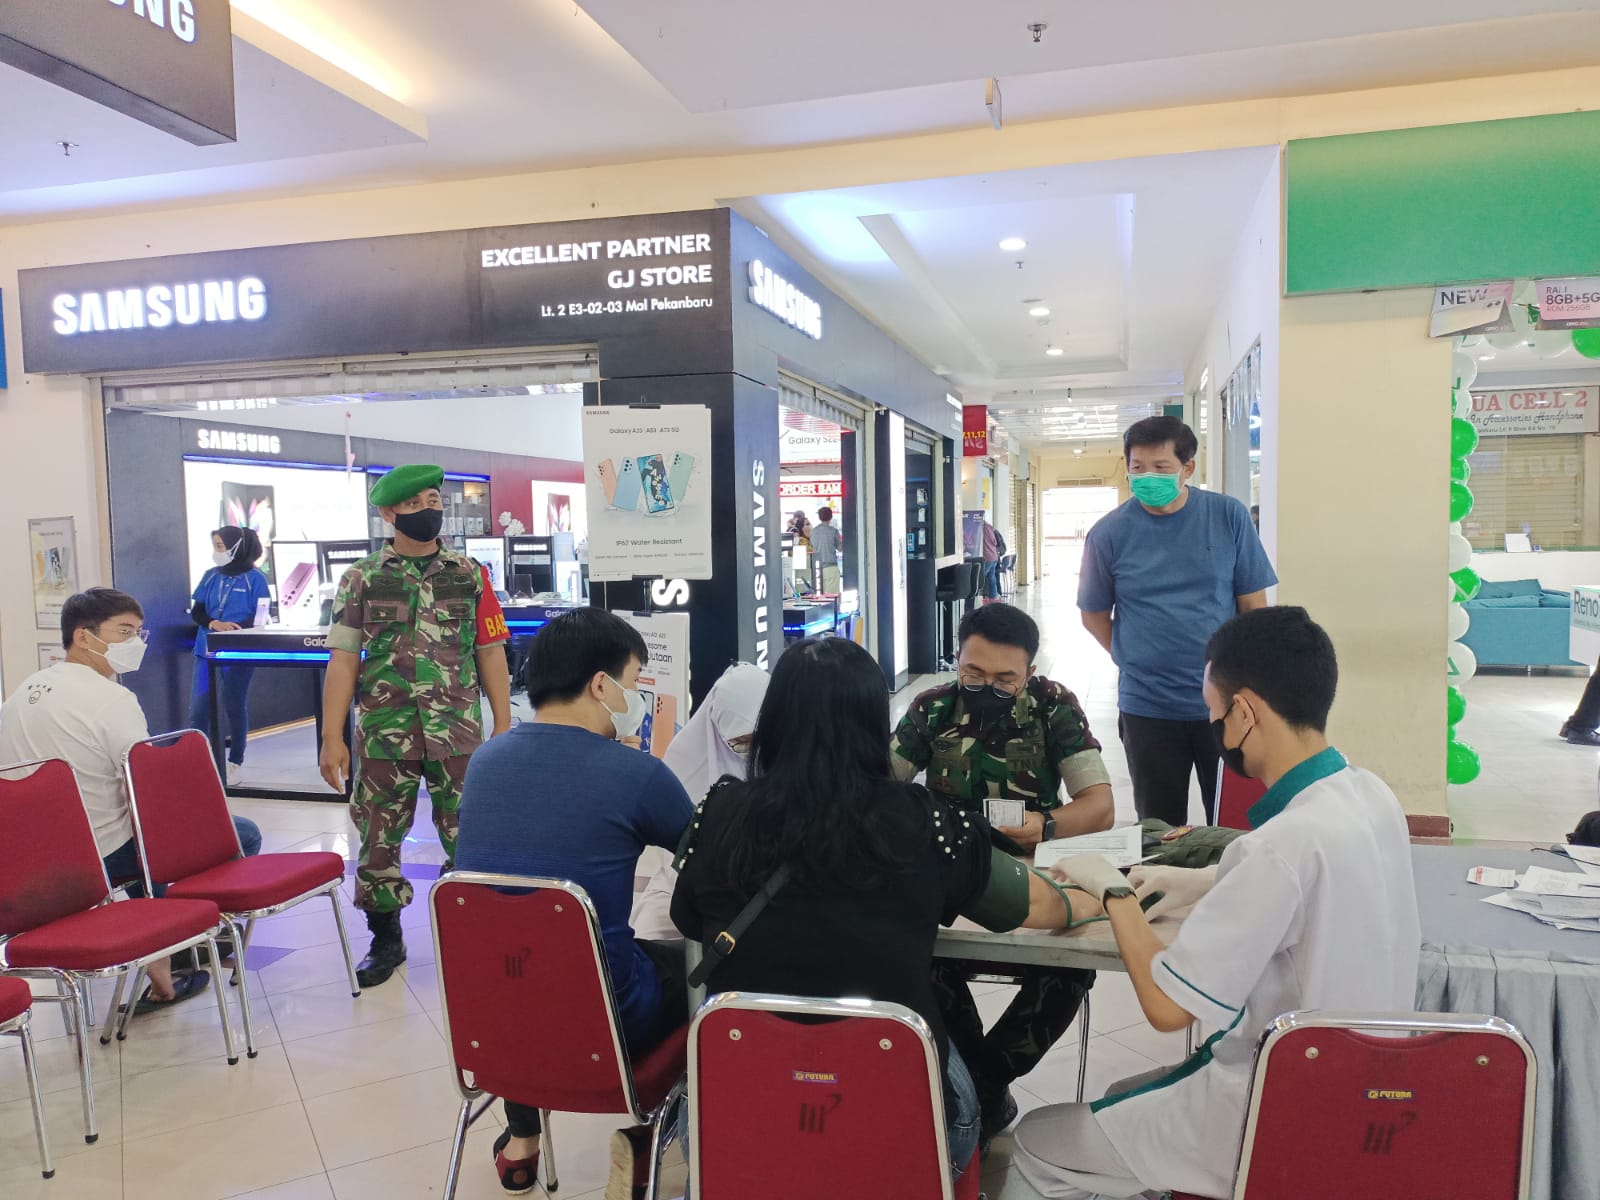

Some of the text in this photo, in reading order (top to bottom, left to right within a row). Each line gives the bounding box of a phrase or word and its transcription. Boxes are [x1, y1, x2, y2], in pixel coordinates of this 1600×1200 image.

[481, 233, 711, 268] EXCELLENT PARTNER
[607, 264, 713, 289] GJ STORE
[51, 276, 268, 336] SAMSUNG
[541, 295, 713, 317] Lt. 2 E3-02-03 Mal Pekanbaru
[748, 258, 822, 341] SAMSUNG
[1440, 288, 1488, 306] NEW
[1509, 390, 1567, 410] CELL
[1575, 390, 1588, 408] 2
[197, 428, 281, 454] SAMSUNG
[788, 436, 821, 445] Galaxy
[752, 459, 768, 671] SAMSUN
[1573, 590, 1599, 619] Reno
[303, 636, 328, 647] Gala
[648, 642, 668, 651] esome
